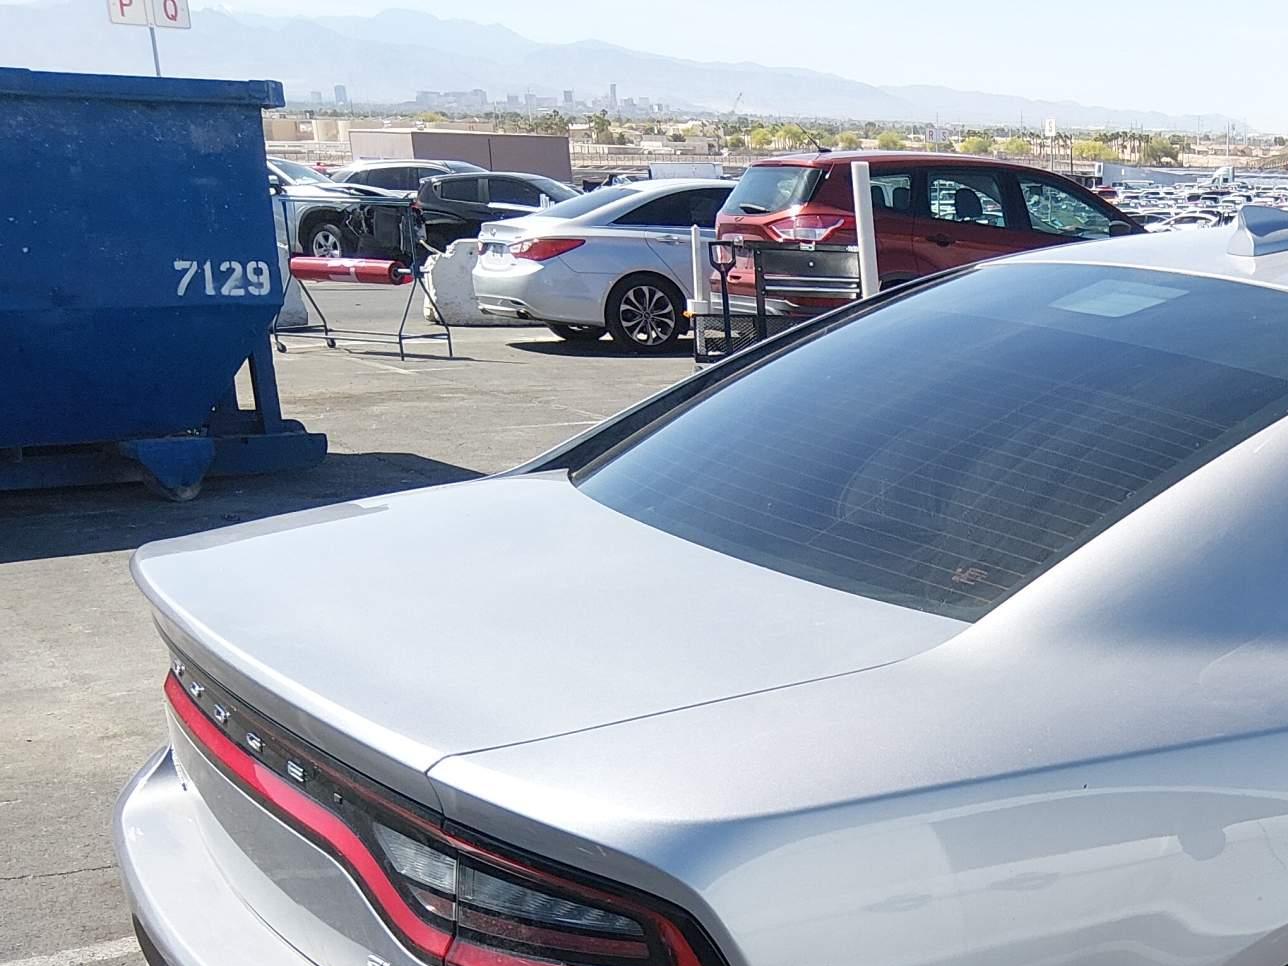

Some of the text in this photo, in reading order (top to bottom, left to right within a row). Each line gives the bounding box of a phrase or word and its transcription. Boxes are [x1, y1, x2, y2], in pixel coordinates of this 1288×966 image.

[118, 0, 133, 17] P
[162, 0, 178, 22] Q
[172, 258, 271, 297] 7129
[172, 657, 306, 783] DODGE
